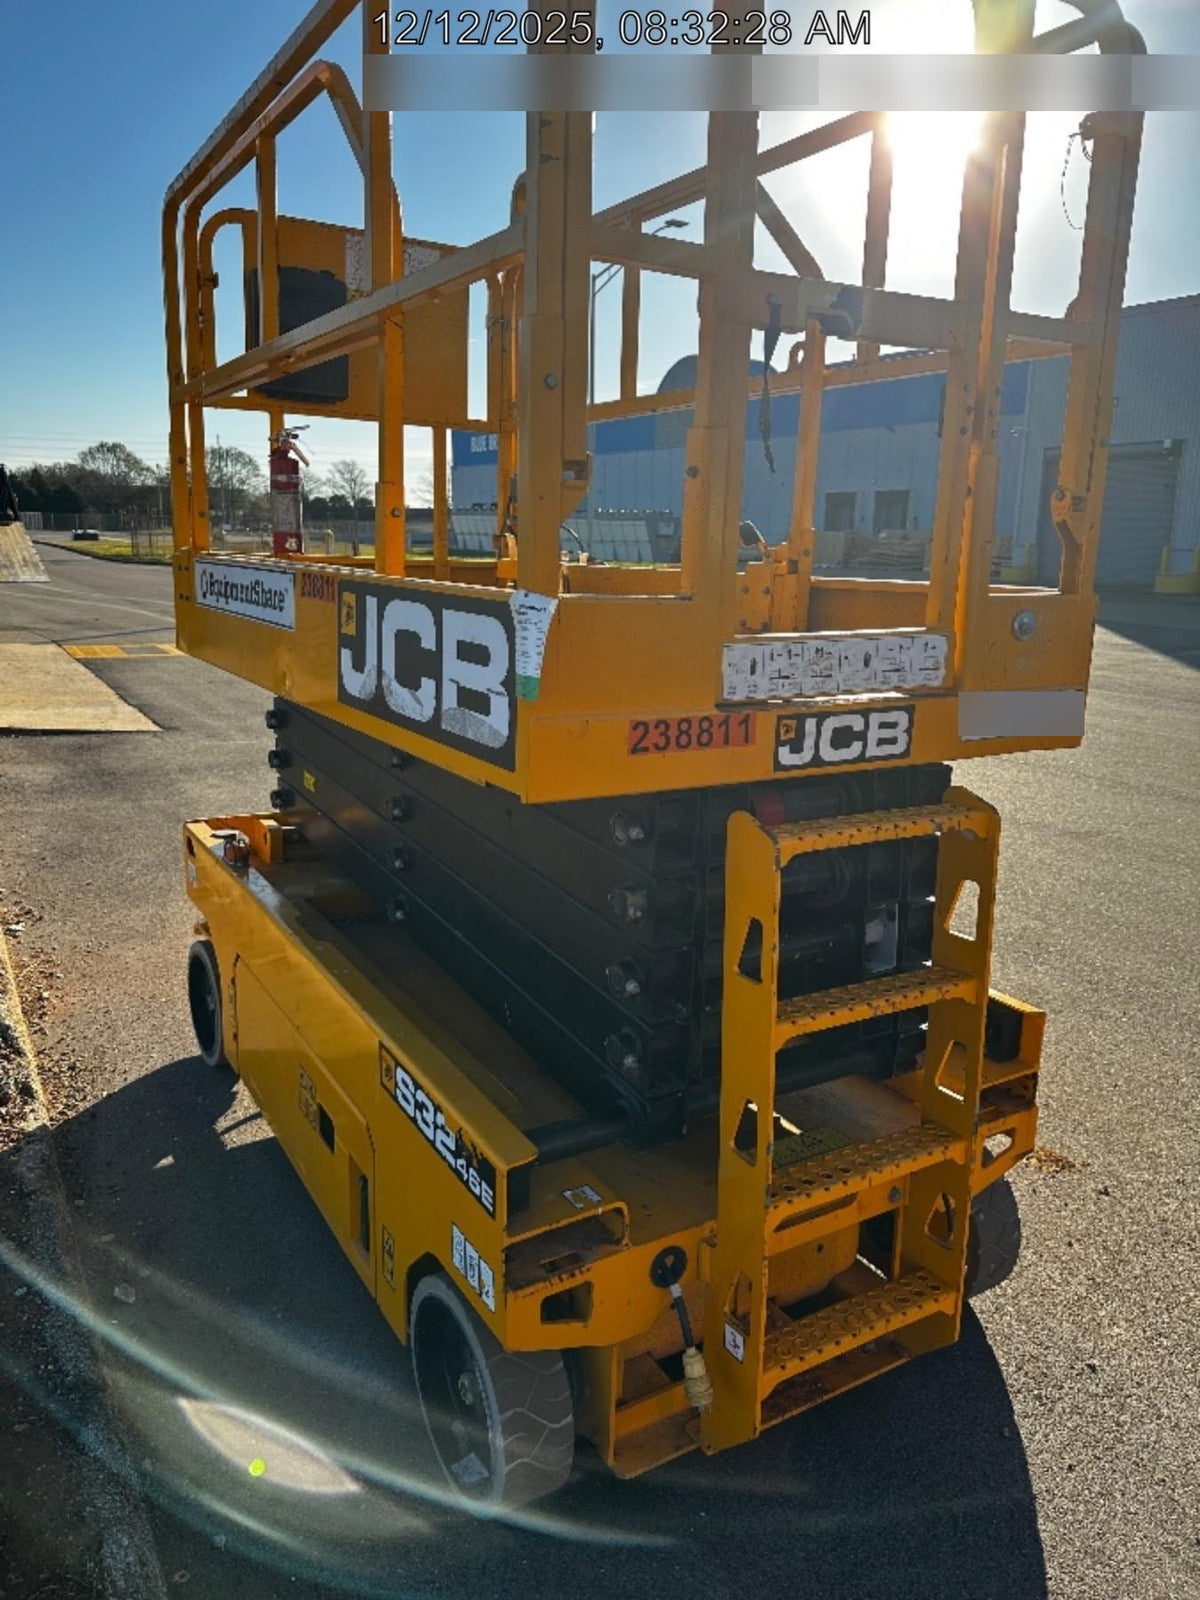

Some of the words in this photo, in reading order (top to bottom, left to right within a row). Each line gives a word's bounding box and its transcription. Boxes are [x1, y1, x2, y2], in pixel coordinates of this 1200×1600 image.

[209, 571, 287, 612] EquipmentShare
[341, 595, 510, 748] JCB
[631, 713, 751, 754] 238811
[778, 711, 910, 766] JCB
